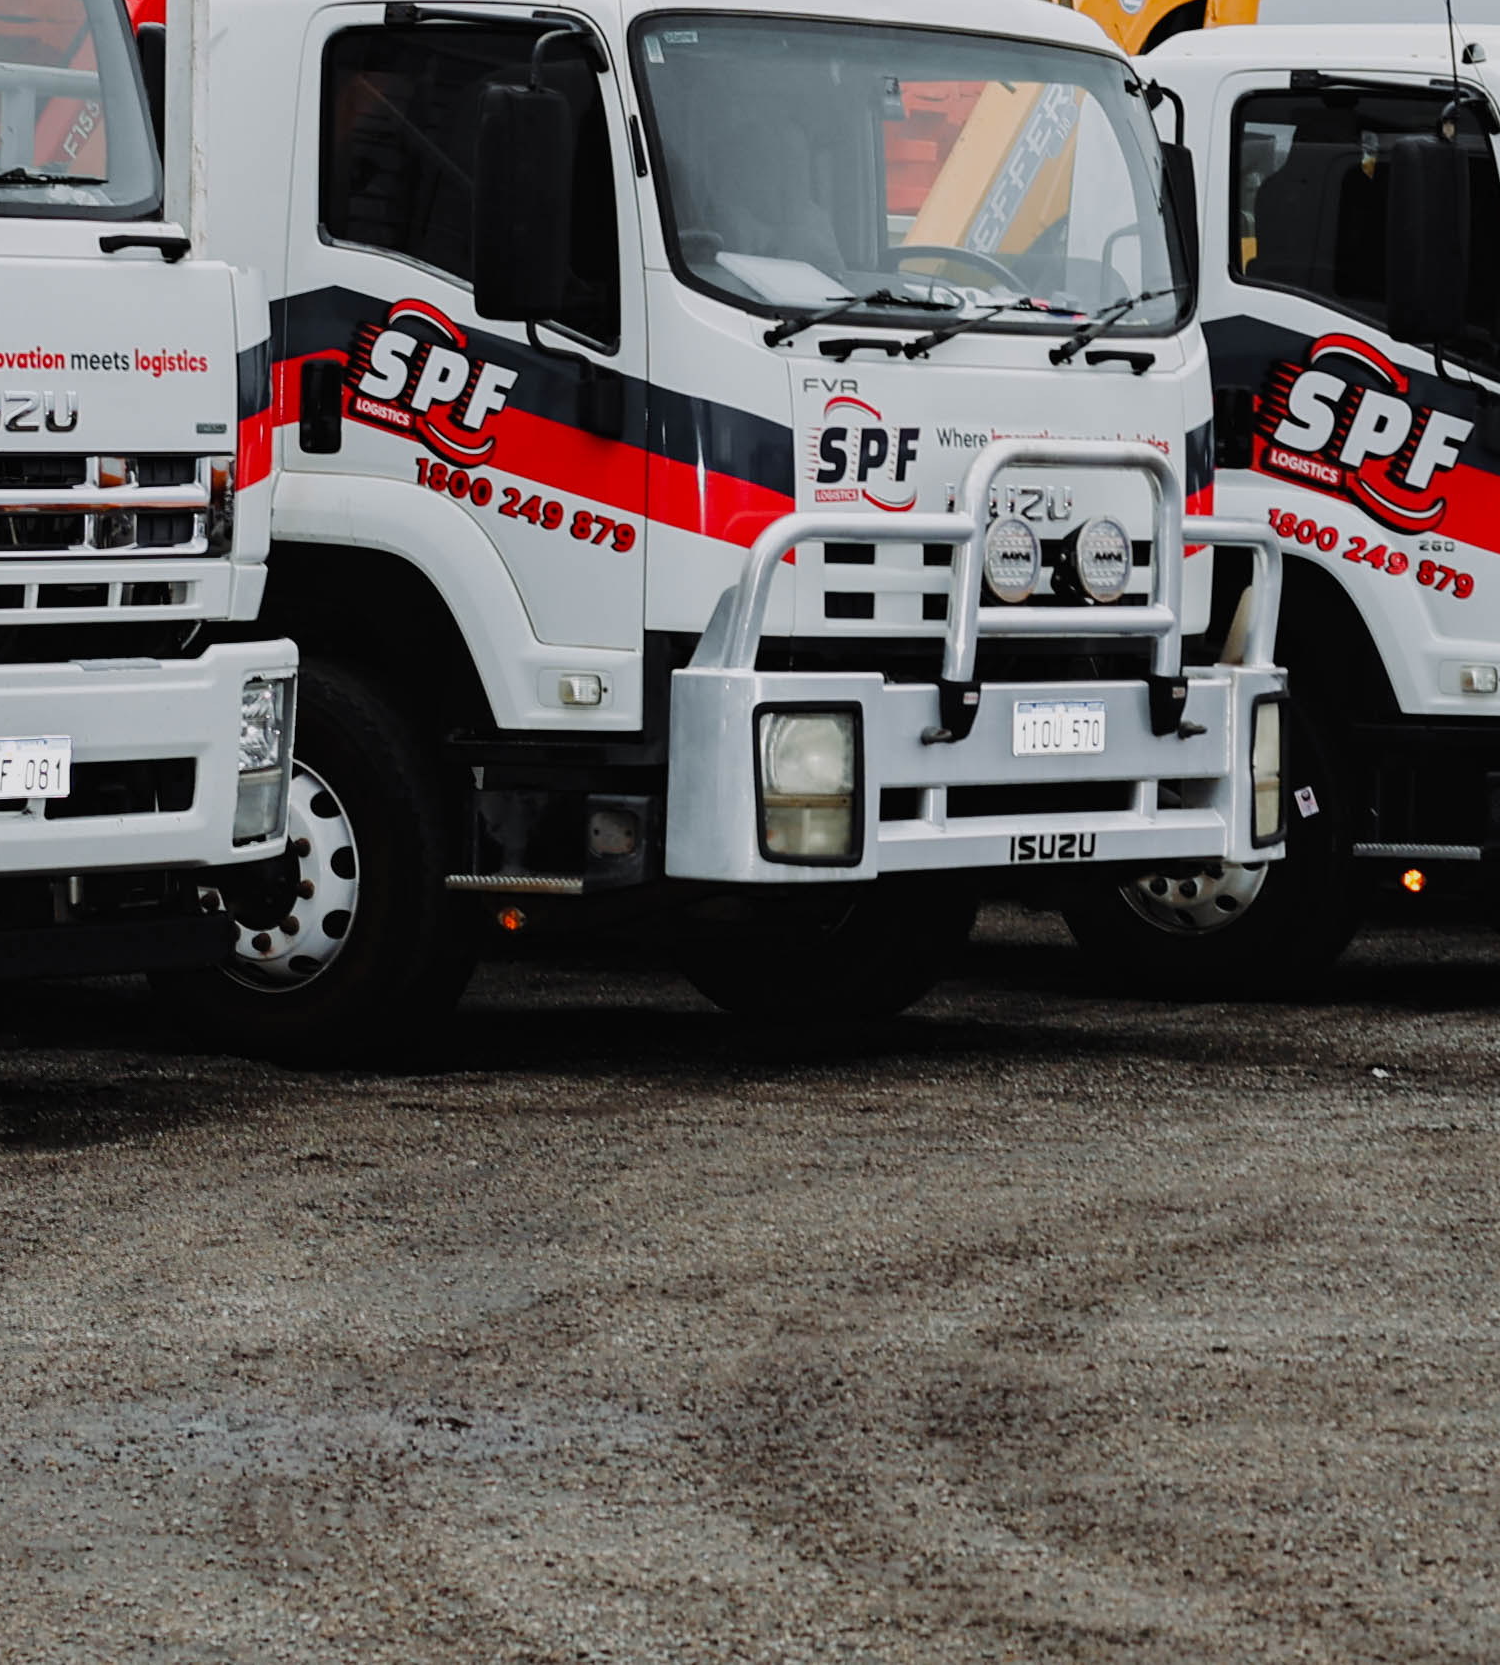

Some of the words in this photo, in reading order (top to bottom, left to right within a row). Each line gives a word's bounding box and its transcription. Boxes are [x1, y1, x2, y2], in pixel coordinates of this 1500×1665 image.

[971, 84, 1068, 256] EFFER
[71, 351, 131, 371] meets
[135, 348, 208, 378] logistics
[358, 330, 519, 430] SPF
[803, 378, 859, 394] FVR
[355, 396, 411, 427] LOGISTICS
[936, 427, 988, 449] Where
[1273, 370, 1475, 490] SPF
[816, 427, 920, 484] SPF
[1270, 449, 1340, 484] LOGISTICS
[415, 457, 493, 507] 1800
[498, 487, 564, 530] 249
[570, 510, 636, 553] 879
[815, 489, 859, 502] LOGISTICS
[946, 483, 1074, 521] IUZU
[1268, 508, 1338, 552] 1800
[1343, 536, 1409, 575] 249
[1416, 560, 1475, 599] 879
[1072, 719, 1101, 748] 570
[25, 758, 62, 791] 081
[1010, 832, 1097, 863] ISUZU
